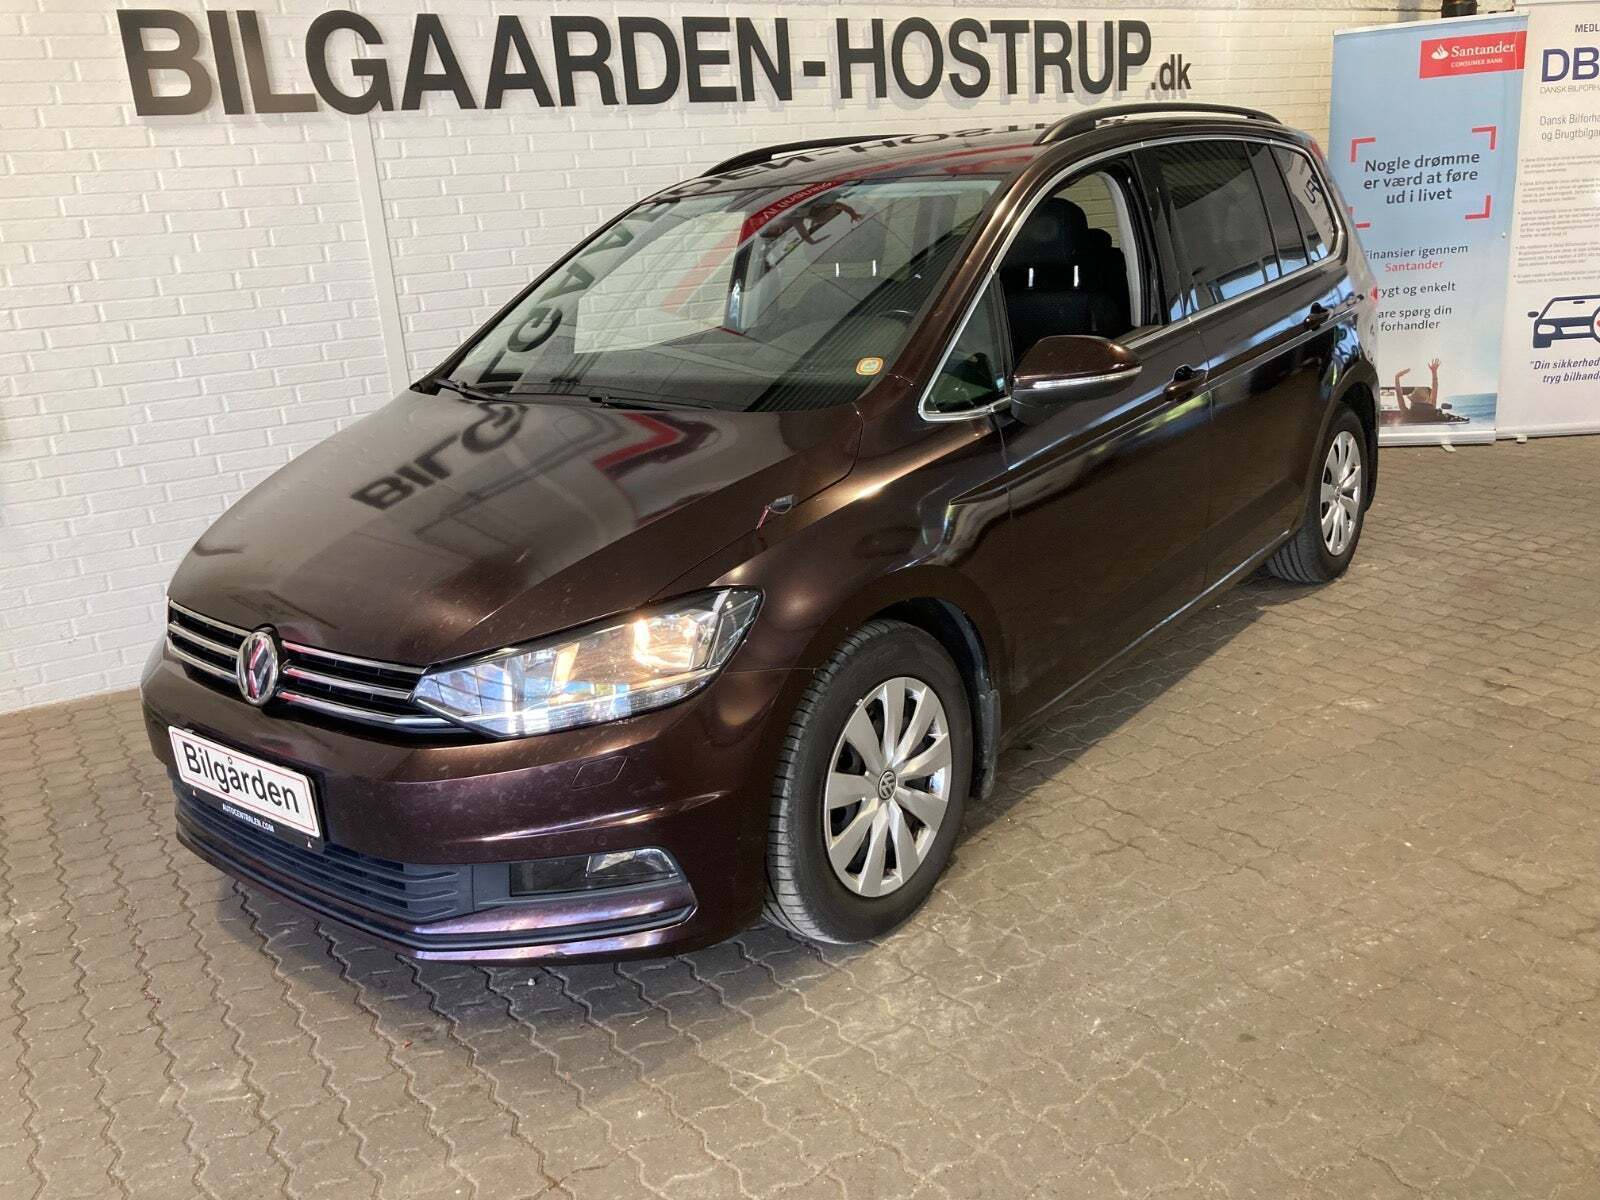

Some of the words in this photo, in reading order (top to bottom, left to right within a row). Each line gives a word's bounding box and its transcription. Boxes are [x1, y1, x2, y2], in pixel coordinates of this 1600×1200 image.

[1451, 41, 1515, 58] Santander
[1451, 59, 1485, 68] CONSUMER
[1540, 85, 1567, 95] DANSK
[1540, 115, 1566, 126] Dansk
[1541, 131, 1552, 141] og
[1365, 157, 1410, 174] Nogle
[1414, 153, 1480, 168] drømme
[1364, 179, 1380, 190] er
[1383, 172, 1422, 188] værd
[1426, 172, 1442, 185] at
[1446, 169, 1478, 182] føre
[1386, 190, 1405, 204] ud
[1418, 188, 1452, 202] livet
[1418, 245, 1468, 259] igennem
[1385, 261, 1445, 273] Santander
[1403, 287, 1417, 297] og
[1420, 281, 1456, 293] enkelt
[1399, 306, 1431, 319] spørg
[1434, 304, 1452, 316] din
[1380, 319, 1440, 332] forhandler
[1542, 374, 1561, 385] tryg
[182, 740, 300, 814] Bilgården
